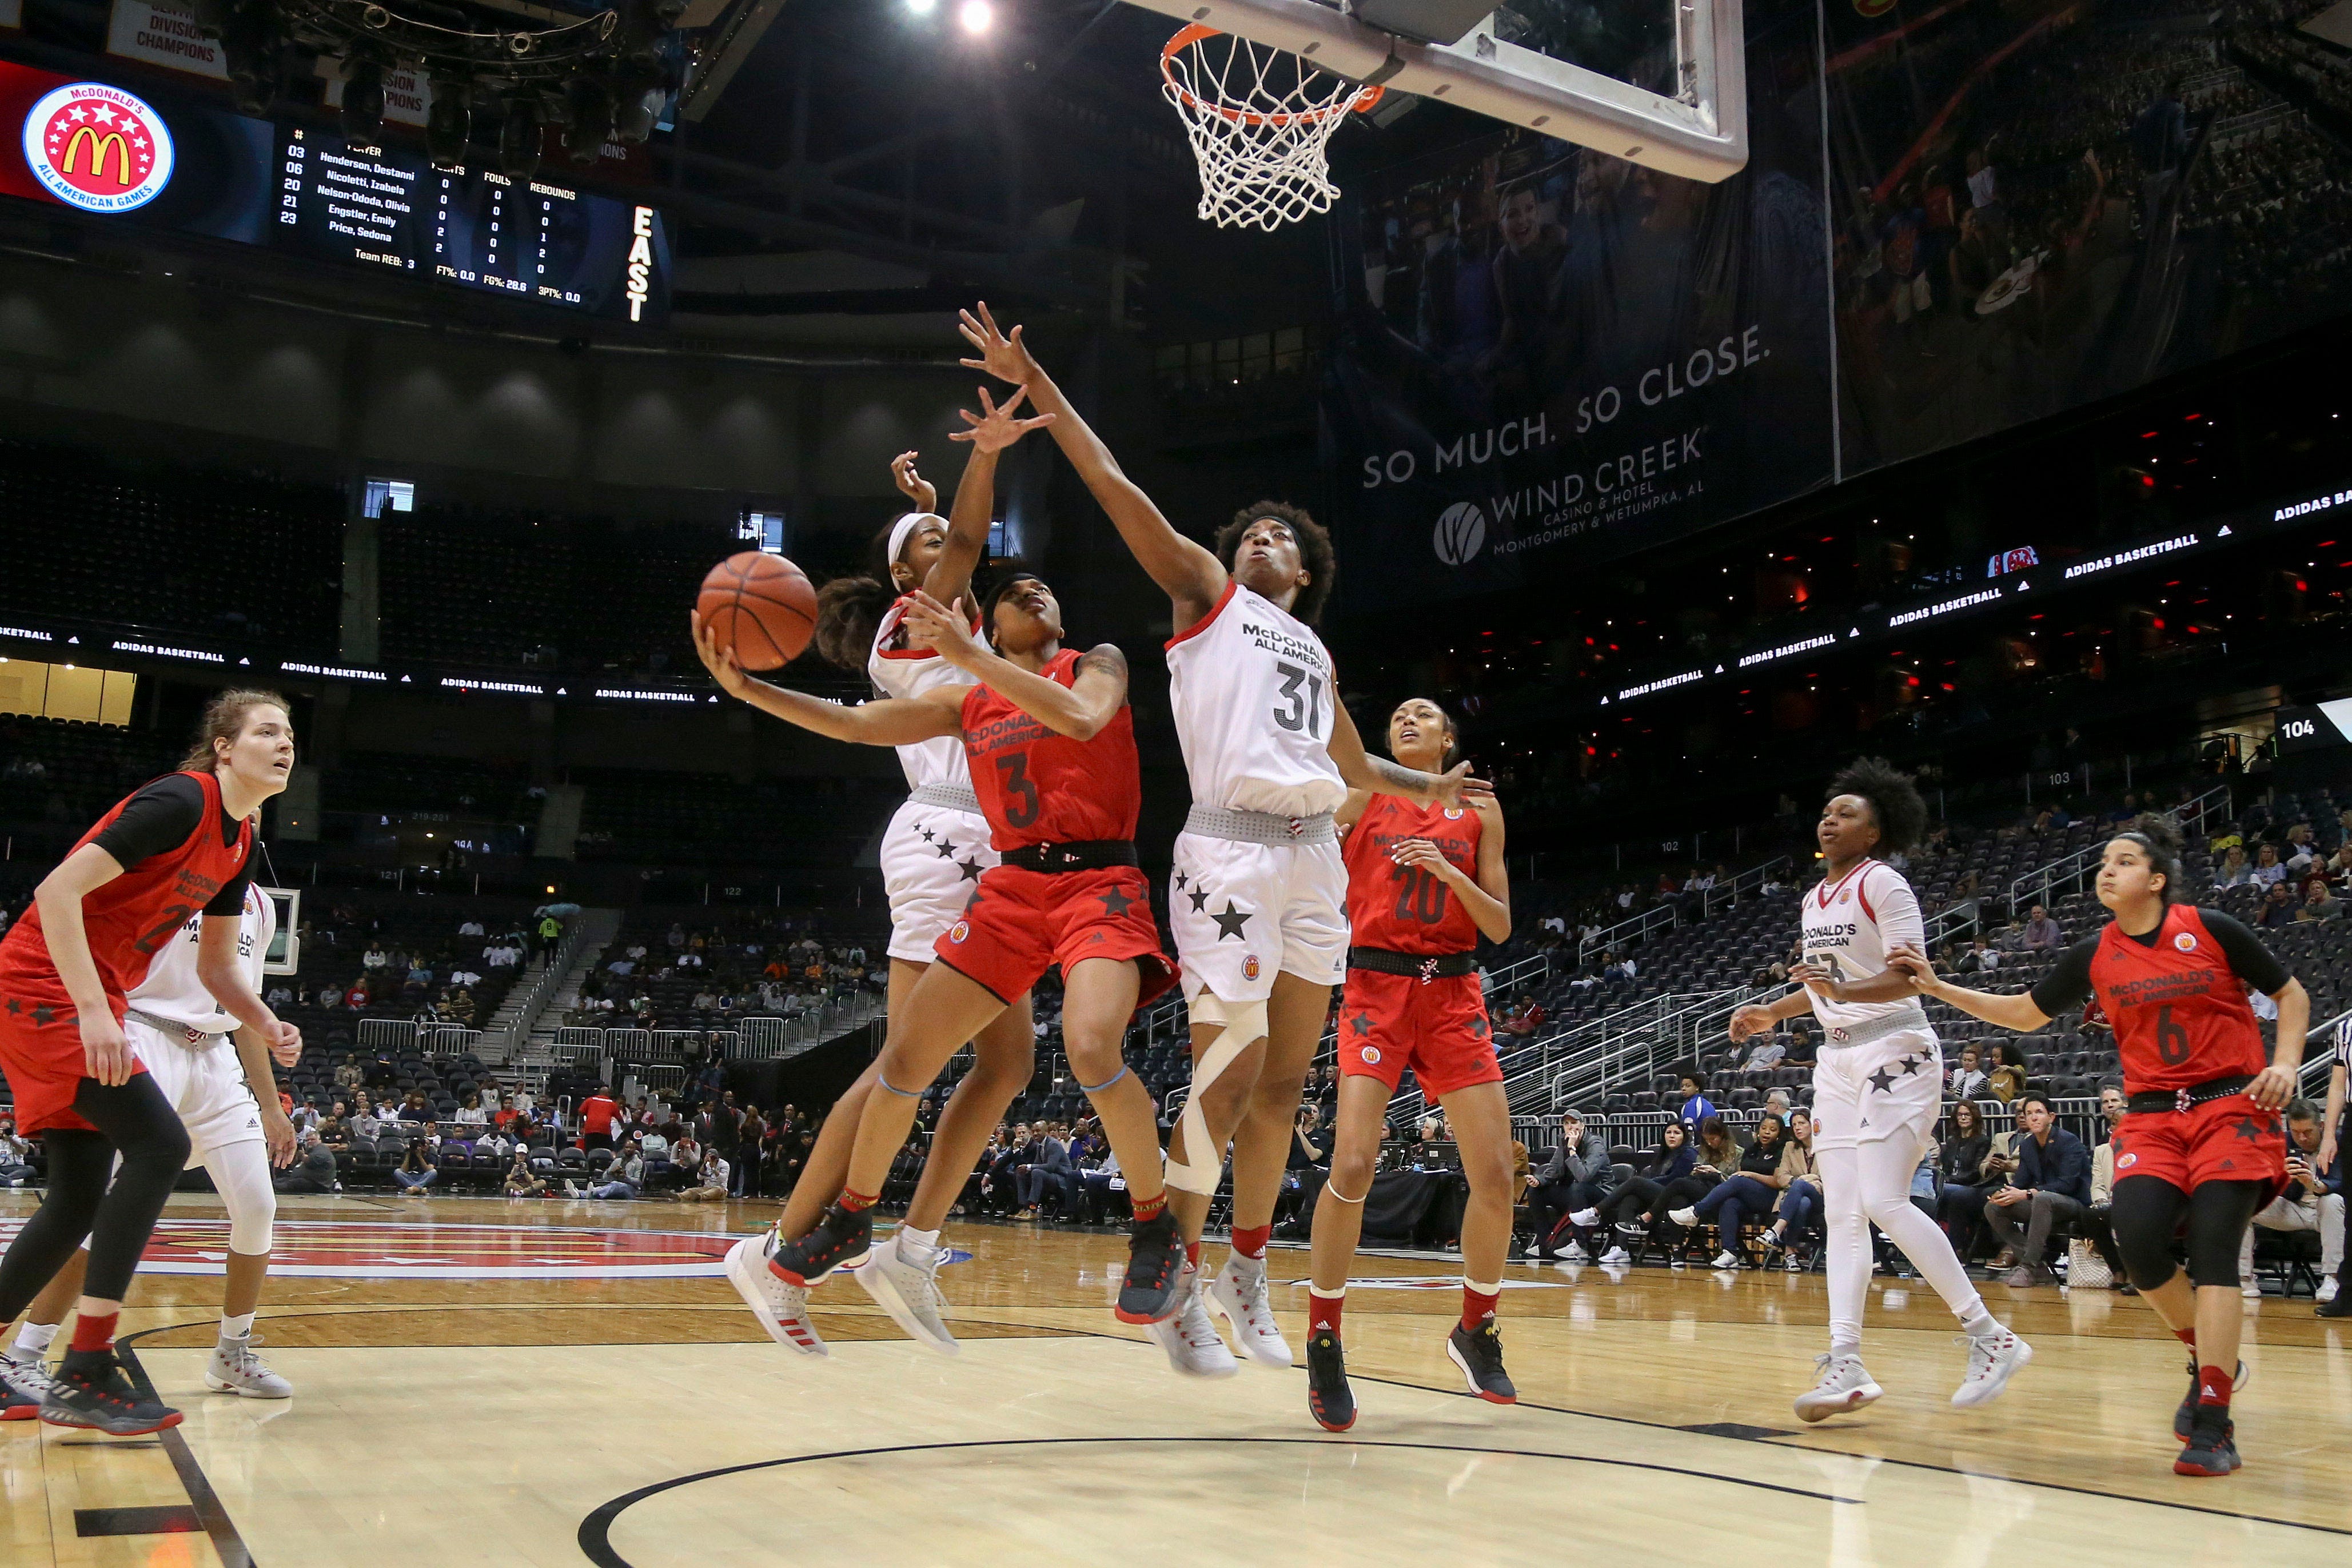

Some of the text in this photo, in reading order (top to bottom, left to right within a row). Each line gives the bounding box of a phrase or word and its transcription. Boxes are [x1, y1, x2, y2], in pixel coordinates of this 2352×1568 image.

[137, 31, 214, 62] CHAMPIONS
[70, 87, 144, 114] McDONALD'S
[385, 91, 422, 111] PIONS
[288, 145, 550, 211] 03 Henderson, Destanni 0 0 0
[294, 129, 304, 140] #
[530, 182, 576, 201] REBOUNDS
[38, 164, 153, 207] ALL AMERICAN GAMES
[286, 162, 549, 226] 06 Nicoletti, Izabela 0 0 0
[284, 178, 547, 242] 20 Nelson-Ododa, Olivia 0 0 1
[283, 194, 545, 258] 21 Engstler, Emily 2 0 2
[281, 211, 544, 274] 23 Price, Sedona 2 0 0
[355, 249, 415, 269] Team REB: 3
[436, 265, 475, 281] FT%: 0.0
[626, 206, 653, 322] EAST
[484, 274, 527, 292] FG%: 28.6
[539, 286, 580, 304] 3PT%: 0.0
[1364, 324, 1771, 489] SO MUCH. SO CLOSE.
[1490, 426, 1703, 524] WIND CREEK
[1494, 521, 1587, 555] MONTGOMERY
[1605, 490, 1682, 524] WETUMPKA,
[1688, 480, 1704, 494] AL
[1544, 500, 1593, 526] CASINO
[1613, 481, 1654, 506] HOTEL
[2275, 496, 2331, 521] ADIDAS
[2065, 534, 2199, 578] ADIDAS BASKETBALL
[1889, 588, 2002, 627] ADIDAS BASKETBALL
[113, 641, 224, 662] ADIDAS BASKETBALL
[1242, 623, 1325, 667] McDONAL
[1254, 638, 1329, 681] ALL AMERIC
[1739, 633, 1836, 667] ADIDAS BASKETBALL
[281, 662, 386, 680] ADIDAS BASKETBALL
[441, 678, 544, 693] ADIDAS BASKETBALL
[1619, 669, 1703, 700] ADIDAS BASKETBALL
[595, 689, 695, 701] ADIDAS BASKETBALL
[1273, 661, 1322, 740] 31
[990, 726, 1061, 750] AMERICA
[2282, 719, 2315, 738] 104
[996, 752, 1039, 828] 3
[2050, 772, 2070, 785] 103
[1374, 835, 1469, 852] McDALD'S
[1662, 841, 1679, 852] 102
[381, 871, 397, 879] 121
[725, 887, 742, 895] 122
[1392, 865, 1446, 924] 20
[1803, 924, 1857, 939] DONALD'S
[1807, 937, 1849, 949] AMERICAN
[2110, 969, 2215, 997] McDONALD'S
[2120, 984, 2210, 1008] ALL AMERICAN
[2156, 1004, 2190, 1066] 6
